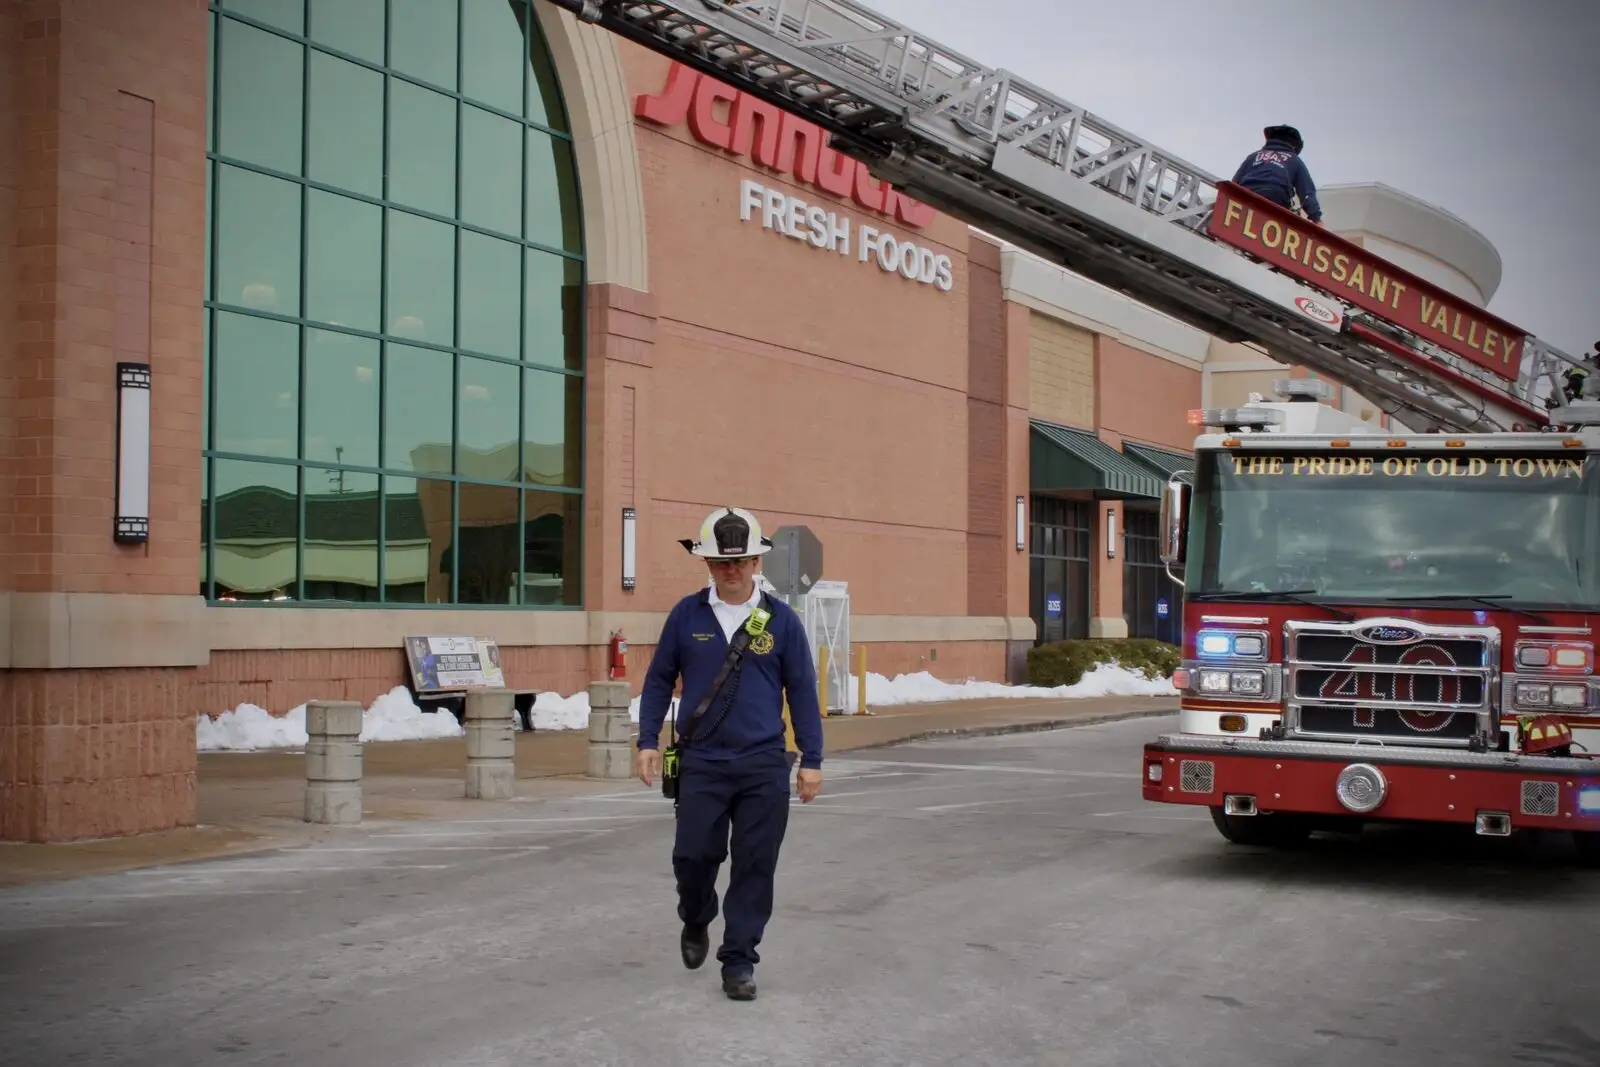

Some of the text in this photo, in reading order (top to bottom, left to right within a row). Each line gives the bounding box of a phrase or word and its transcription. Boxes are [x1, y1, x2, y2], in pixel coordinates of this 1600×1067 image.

[740, 179, 953, 292] FRESH FOODS
[1223, 199, 1517, 364] FLORISSANT VALLEY
[1232, 456, 1586, 479] THE PRIDE OF OLD TOWN
[1368, 626, 1408, 640] Pierce
[1319, 643, 1461, 732] 40
